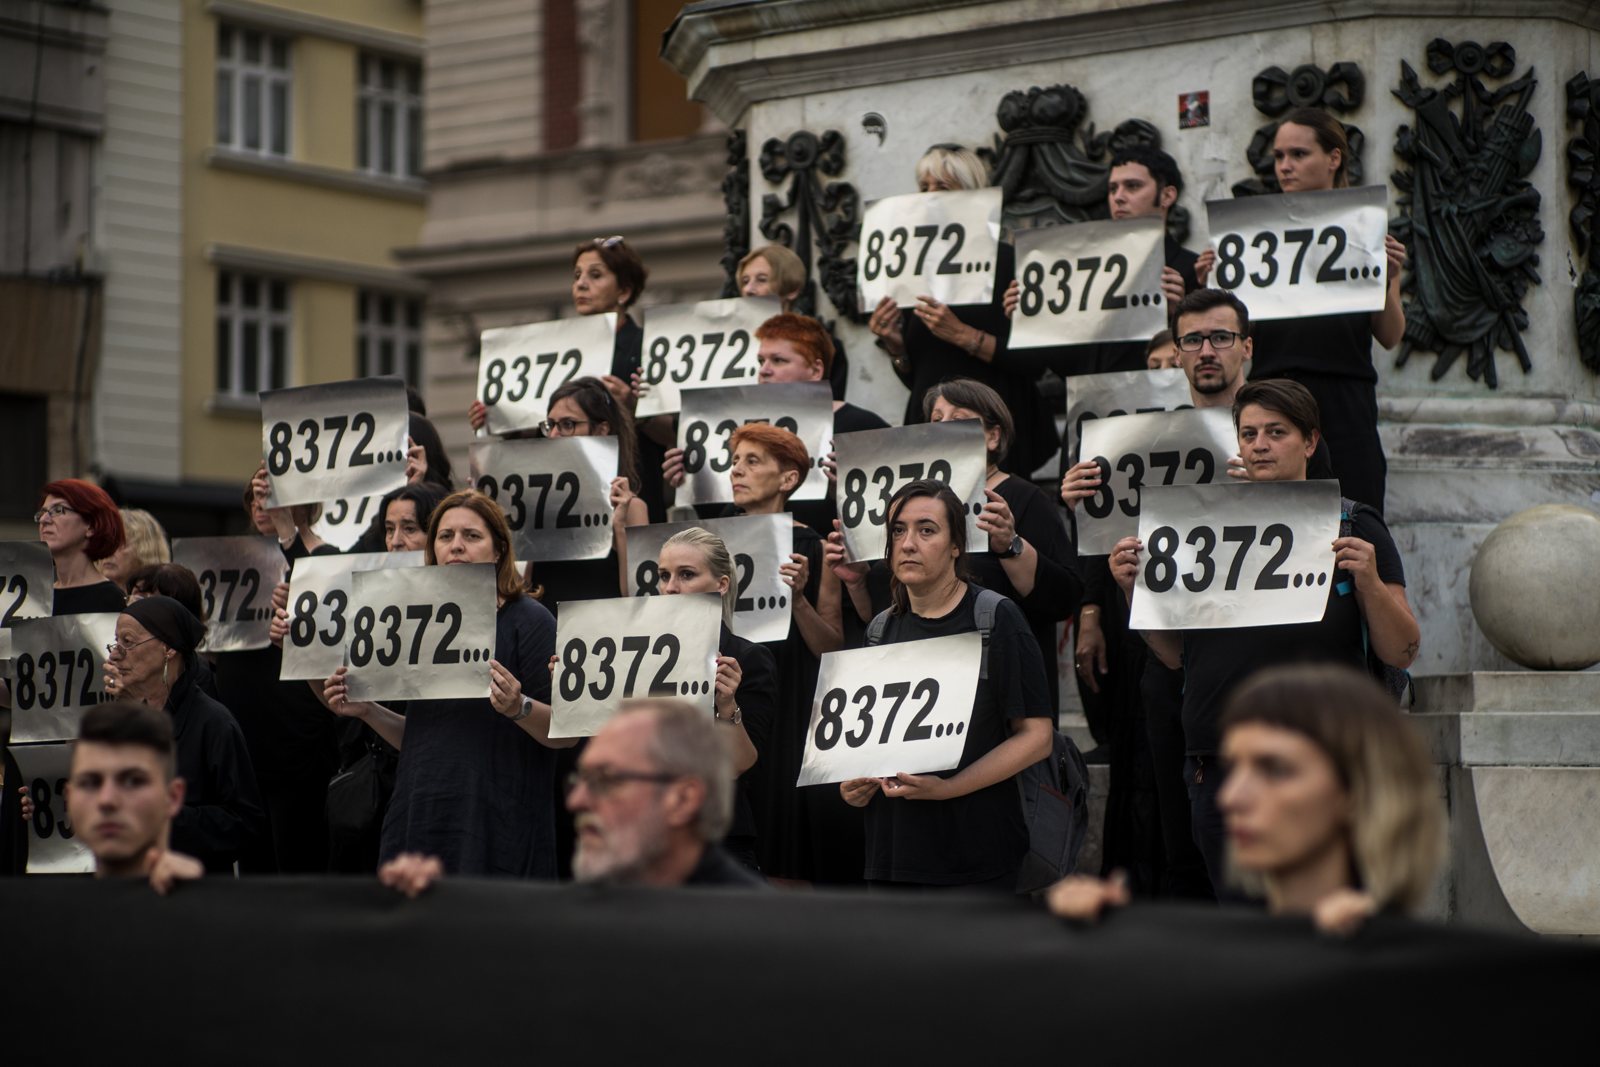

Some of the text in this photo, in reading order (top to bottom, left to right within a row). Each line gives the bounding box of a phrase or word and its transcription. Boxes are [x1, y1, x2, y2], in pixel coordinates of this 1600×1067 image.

[863, 222, 991, 282] 8372...
[1020, 253, 1162, 317] 8372...
[1216, 225, 1382, 291] 8372...
[267, 412, 403, 477] 8372...
[1144, 523, 1326, 593] 8372...
[350, 602, 490, 668] 8372...
[559, 632, 709, 702] 8372...
[814, 677, 965, 751] 8372...
